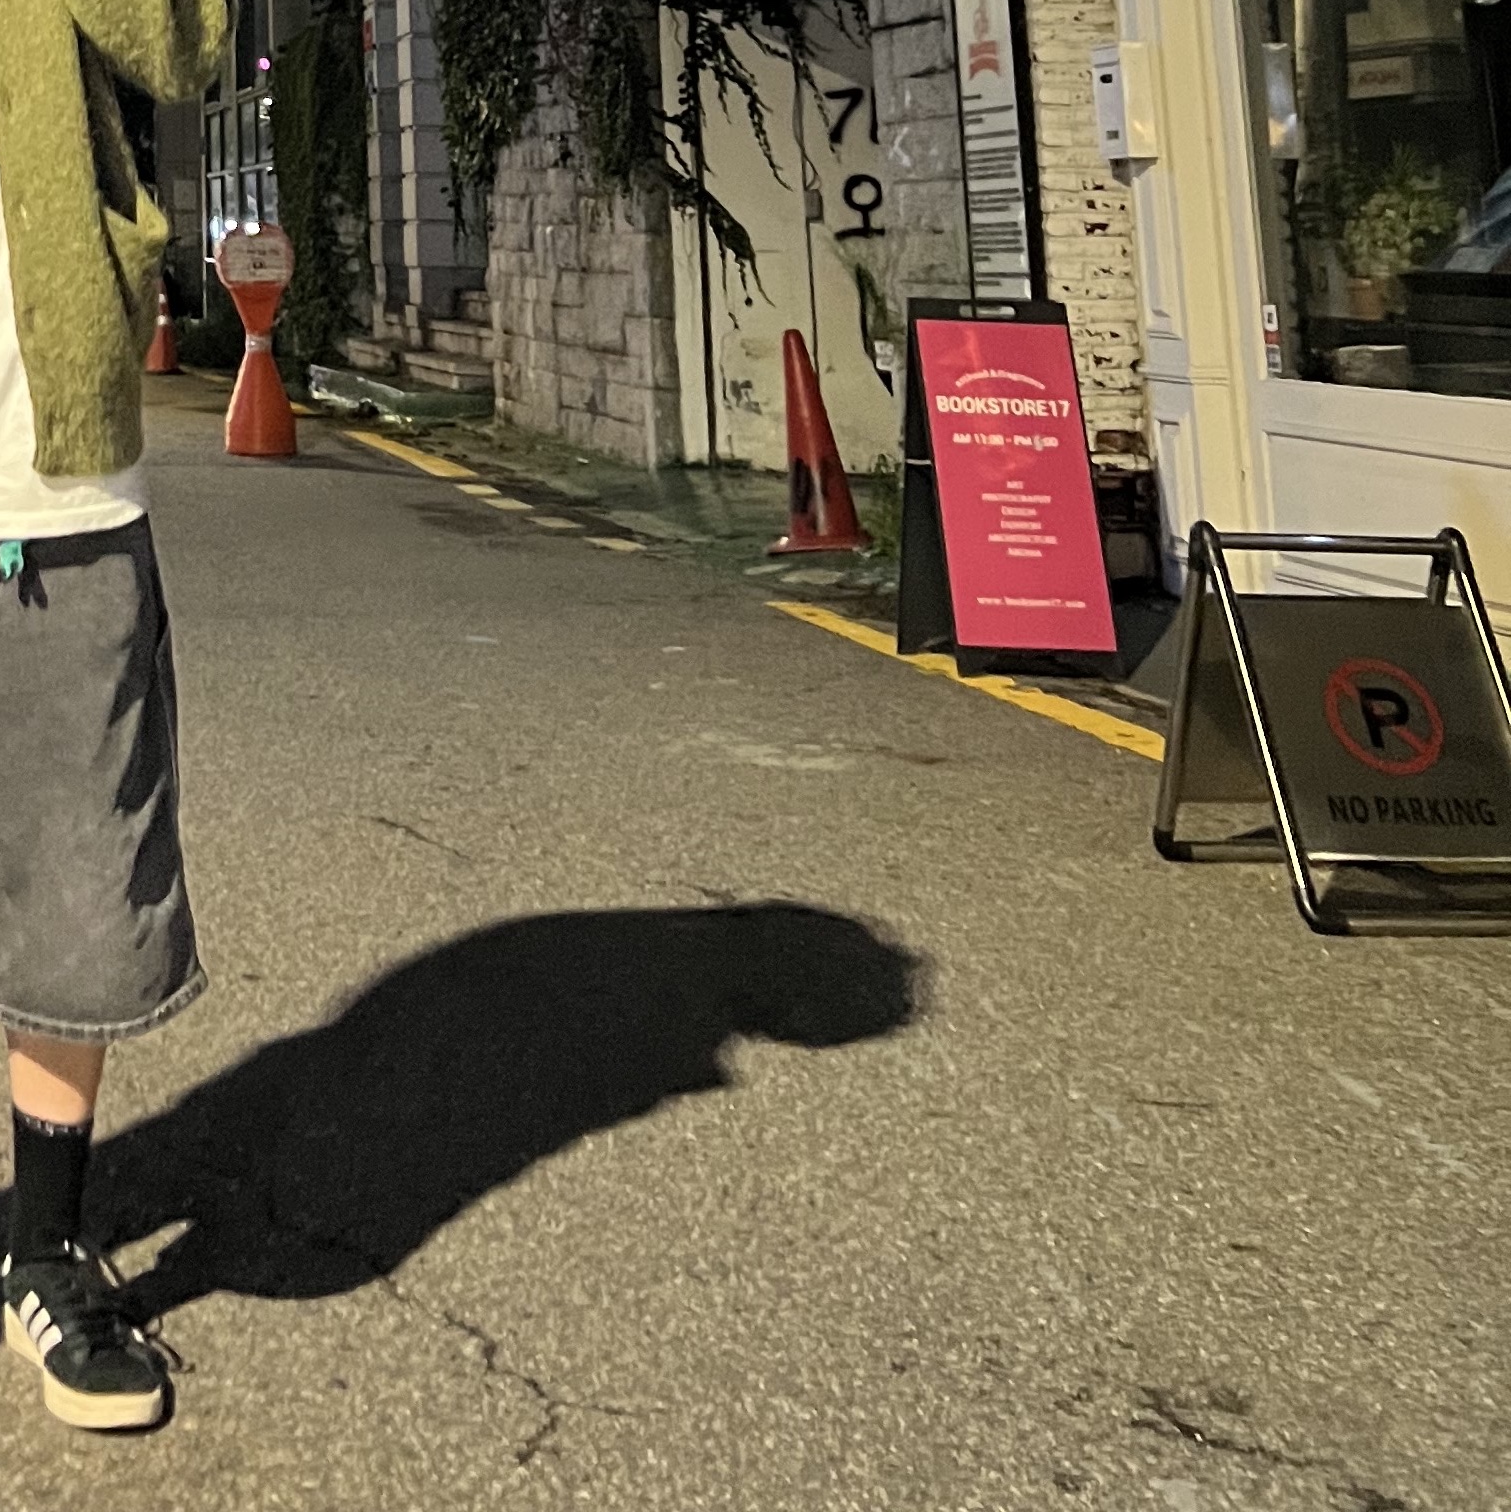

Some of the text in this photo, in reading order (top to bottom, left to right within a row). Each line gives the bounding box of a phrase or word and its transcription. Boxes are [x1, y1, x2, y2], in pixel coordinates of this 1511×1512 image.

[935, 395, 1071, 418] BOOKSTORE17
[1327, 795, 1497, 827] NO PARKING
